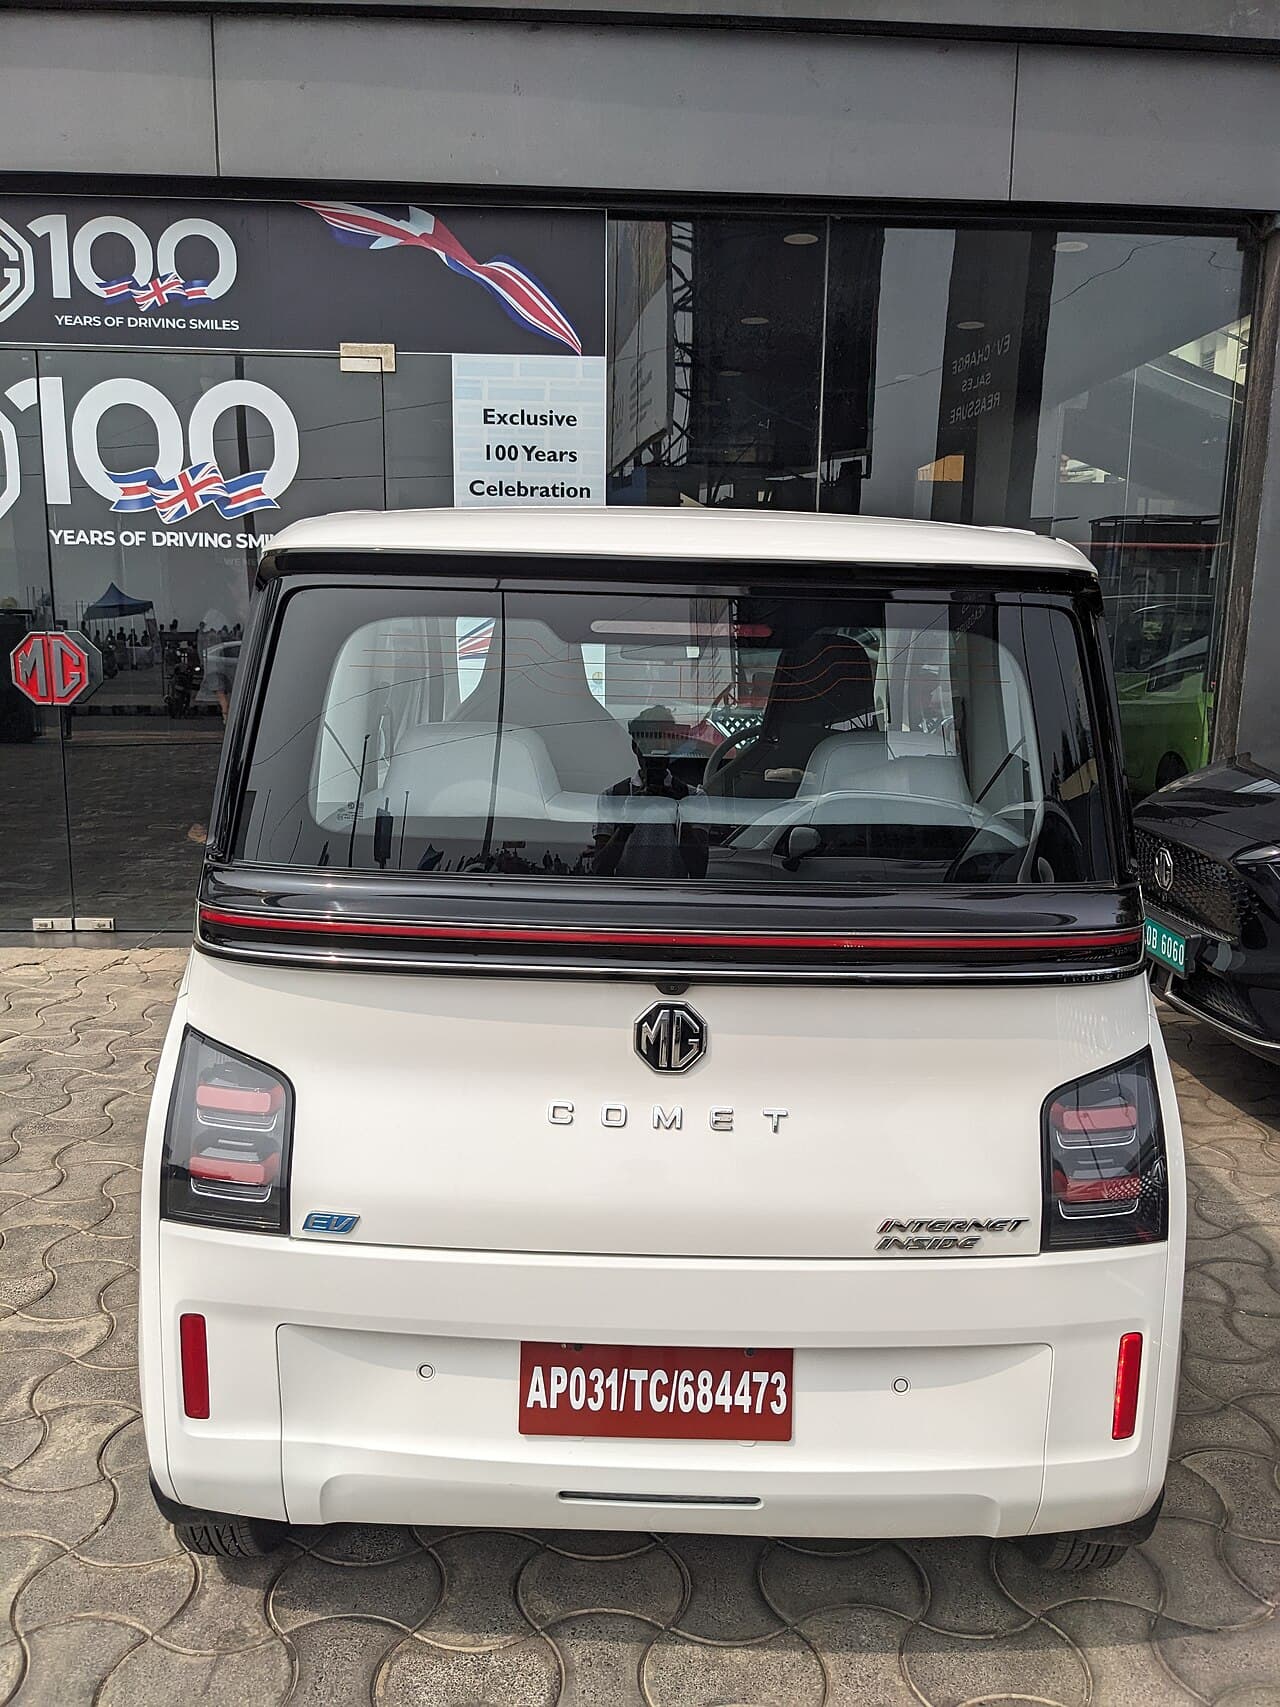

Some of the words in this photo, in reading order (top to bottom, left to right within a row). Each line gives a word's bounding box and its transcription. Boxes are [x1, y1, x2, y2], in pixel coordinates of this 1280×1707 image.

[26, 214, 238, 301] 100
[54, 314, 102, 328] YEARS
[104, 316, 124, 328] OF
[127, 317, 187, 330] DRIVING
[189, 318, 240, 332] SMILES
[482, 407, 578, 427] Exclusive
[4, 376, 300, 505] 100
[485, 443, 519, 462] 100
[521, 444, 578, 463] Years
[468, 479, 592, 499] Celebration
[50, 529, 116, 546] YEARS
[119, 531, 147, 547] OF
[152, 531, 233, 549] DRIVING
[235, 533, 275, 550] SMI
[18, 638, 81, 698] MG
[1161, 933, 1185, 966] 6060
[641, 1009, 701, 1068] MG
[547, 1101, 789, 1134] COMET
[308, 1214, 353, 1231] EV
[876, 1218, 1030, 1233] INTERNET
[875, 1236, 982, 1250] INSIDE
[526, 1365, 789, 1415] AP031/TC/684473
